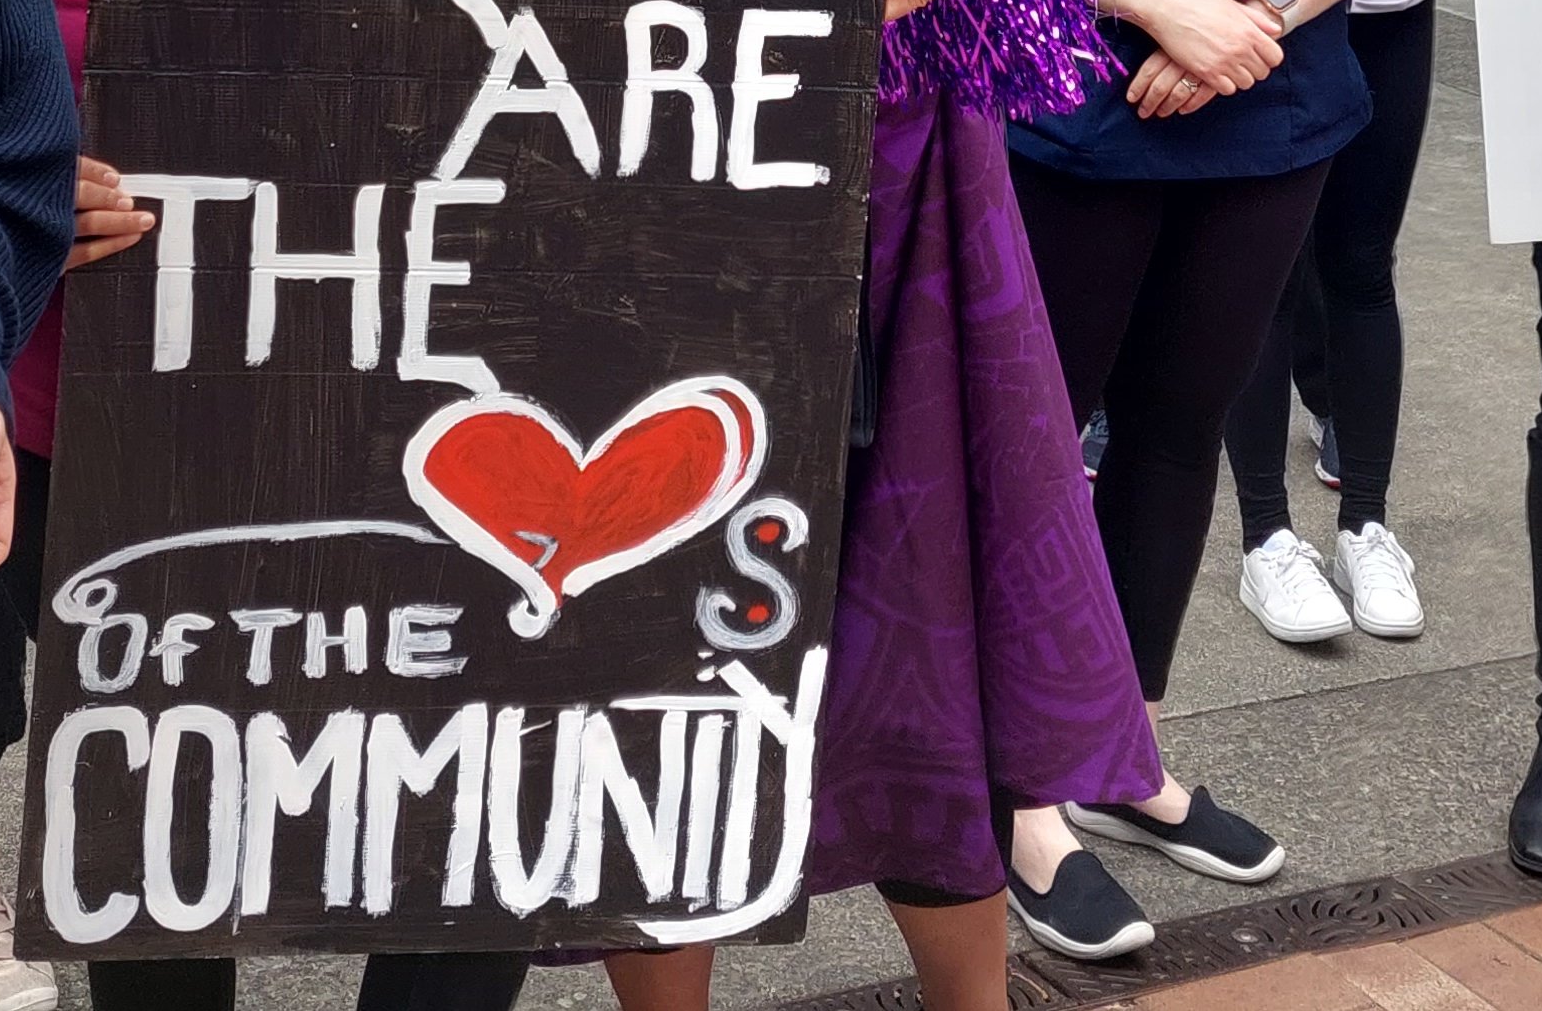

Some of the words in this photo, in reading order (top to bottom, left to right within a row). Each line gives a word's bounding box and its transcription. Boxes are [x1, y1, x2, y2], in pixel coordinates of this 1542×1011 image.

[435, 0, 833, 190] ARE
[119, 174, 507, 388] THE
[228, 605, 470, 687] THE
[42, 645, 827, 945] COMMUNITY
